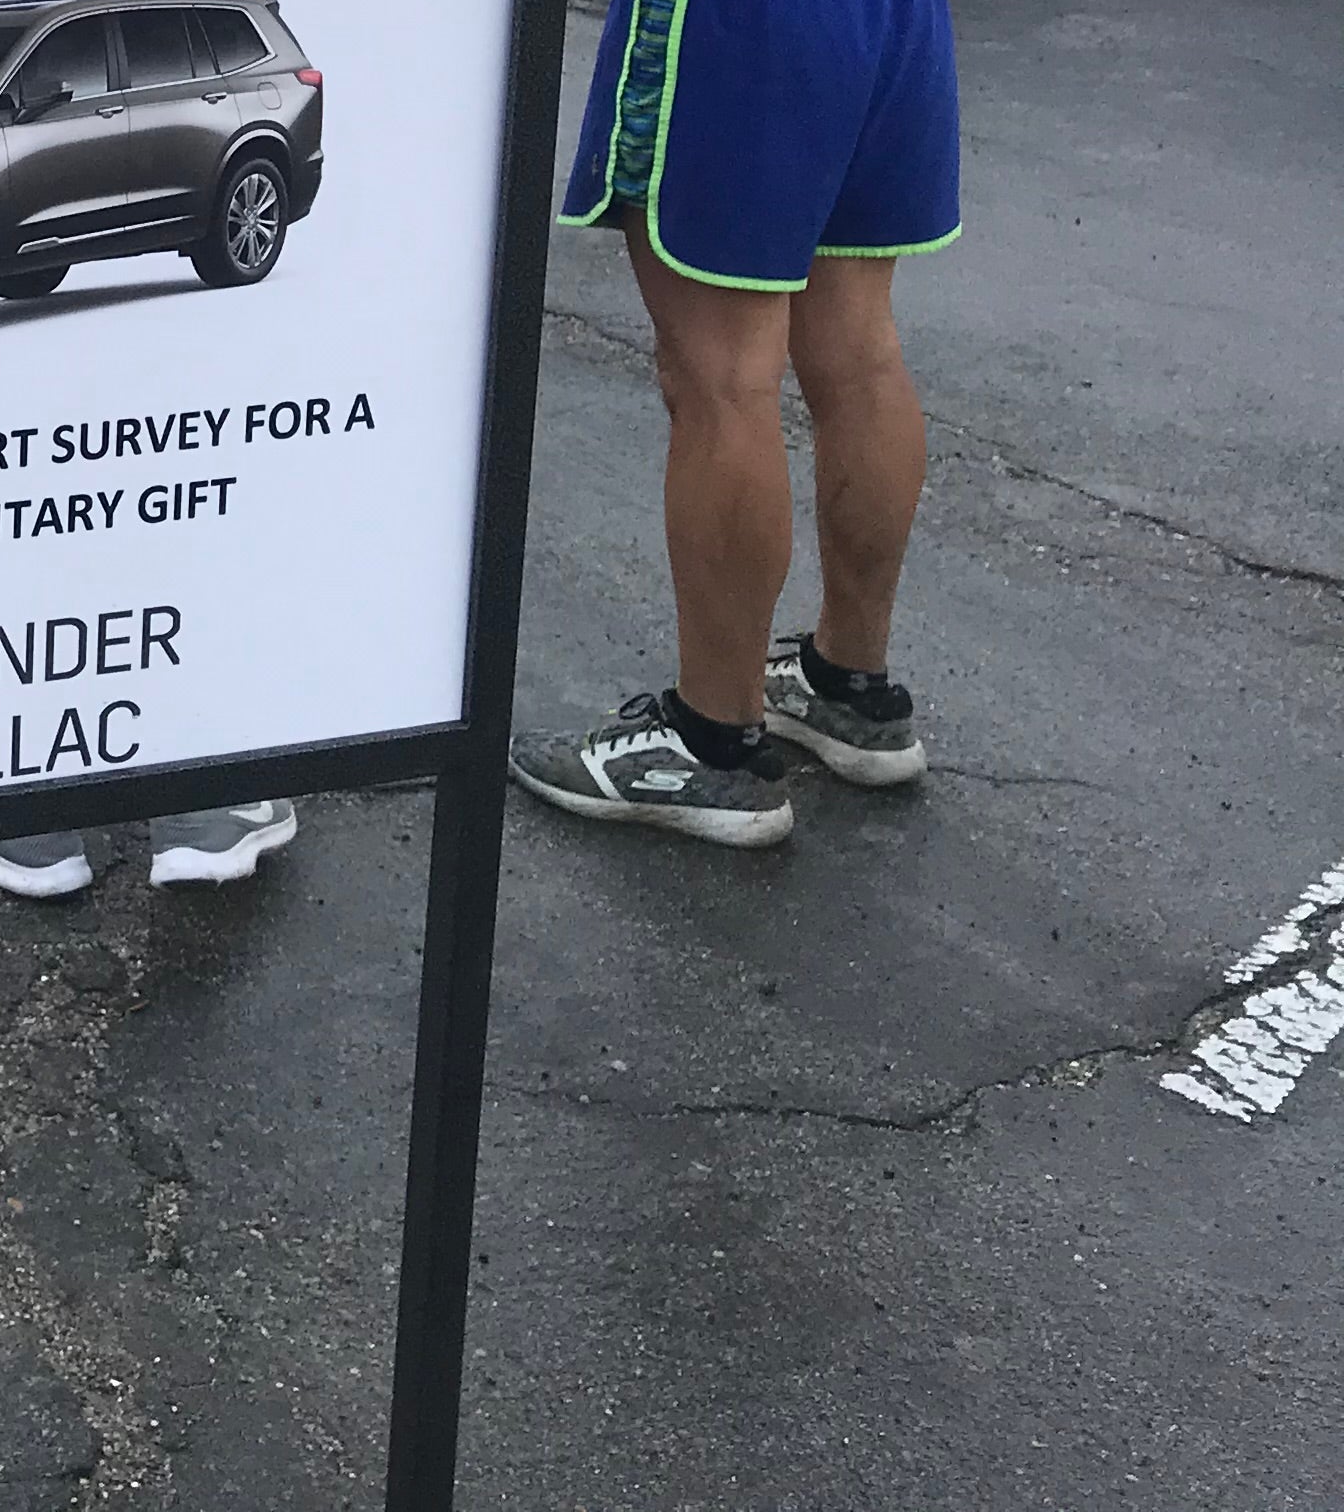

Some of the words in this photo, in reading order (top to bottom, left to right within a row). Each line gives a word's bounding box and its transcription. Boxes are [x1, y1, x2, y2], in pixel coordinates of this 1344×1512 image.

[52, 408, 231, 464] SURVEY
[245, 399, 331, 443] FOR
[345, 393, 375, 433] A
[138, 477, 237, 524] GIFT
